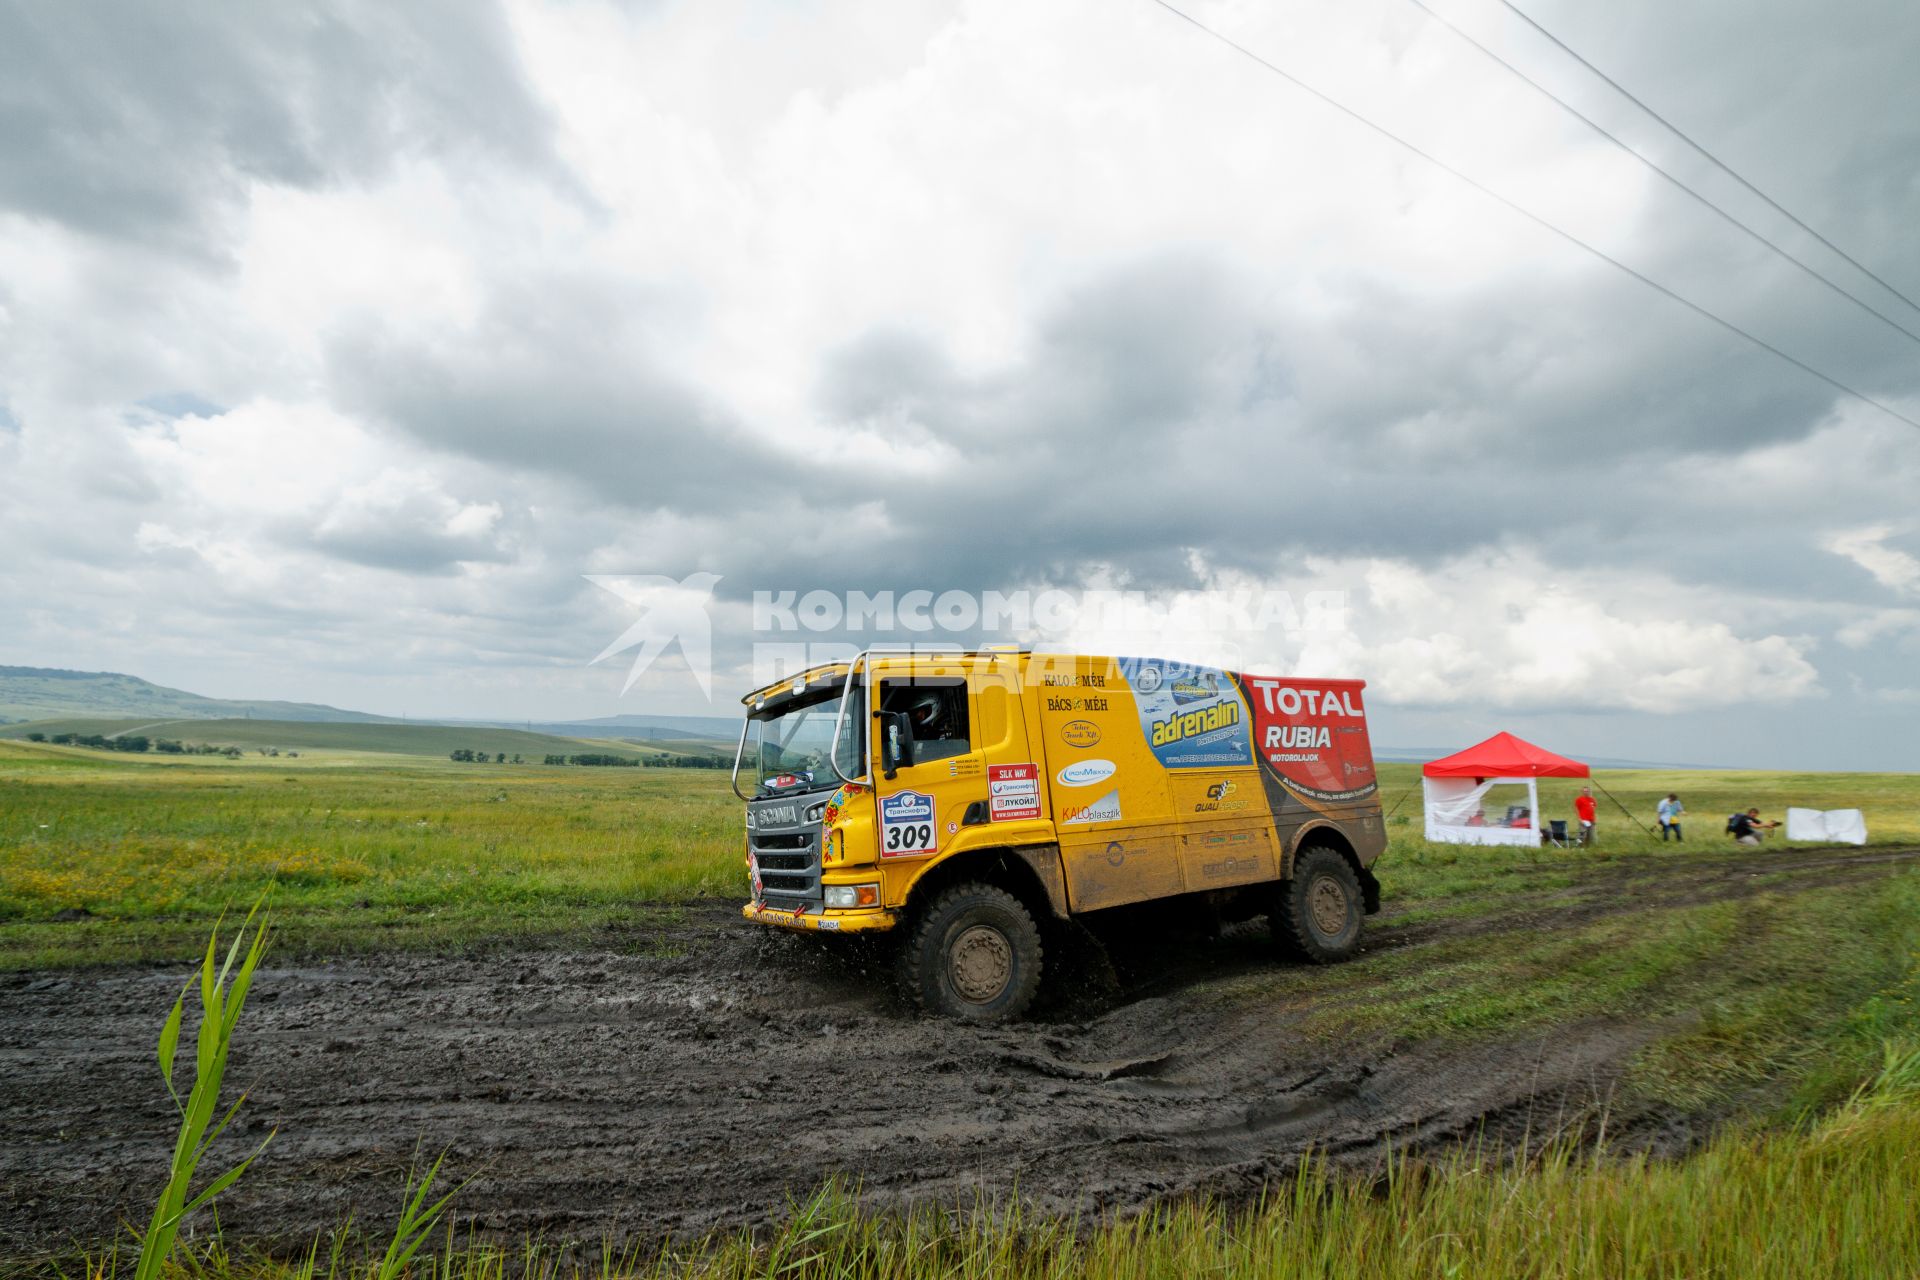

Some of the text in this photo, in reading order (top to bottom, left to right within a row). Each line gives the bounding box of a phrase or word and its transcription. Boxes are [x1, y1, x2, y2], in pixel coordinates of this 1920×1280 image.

[1044, 672, 1105, 687] KALO MÉH
[1048, 695, 1108, 711] BÁCS MÉH
[1253, 680, 1363, 717] TOTAL
[1152, 699, 1239, 748] adrenalin
[1265, 726, 1331, 748] RUBIA
[1270, 753, 1319, 762] MOTOROLAJOK
[999, 769, 1027, 779] SILK WAY
[1005, 797, 1034, 806] ЛУКОЙЛ
[760, 806, 796, 825] SCANIA
[887, 825, 931, 849] 309
